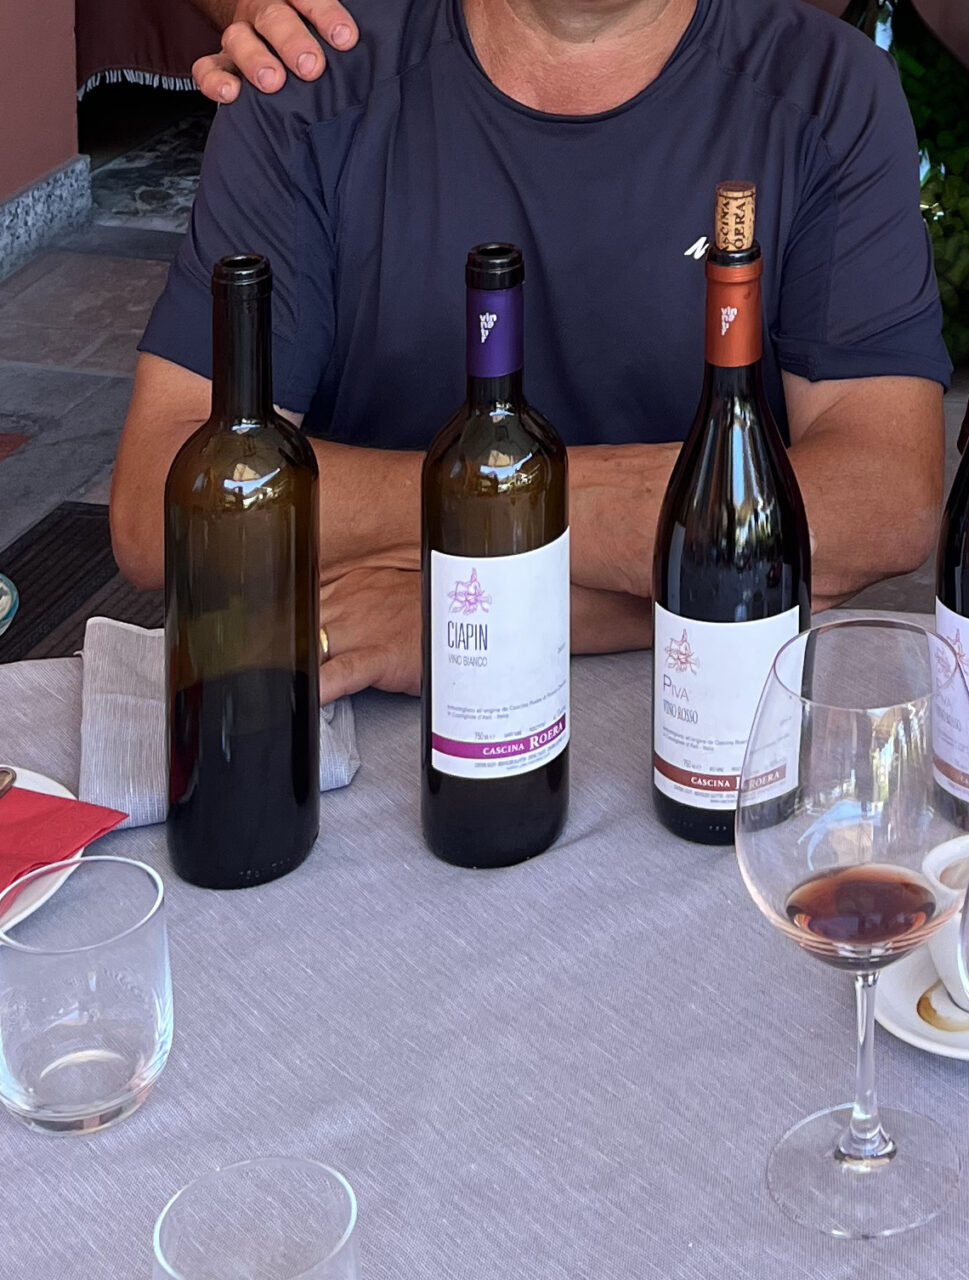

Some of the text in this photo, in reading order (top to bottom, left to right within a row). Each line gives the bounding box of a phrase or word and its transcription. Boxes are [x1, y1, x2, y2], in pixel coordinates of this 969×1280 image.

[733, 201, 746, 249] OERA
[447, 620, 488, 651] CIAPIN
[677, 706, 698, 724] ROSSO
[482, 721, 563, 756] CASCINA ROERA
[690, 770, 780, 791] CASCINA ROERA
